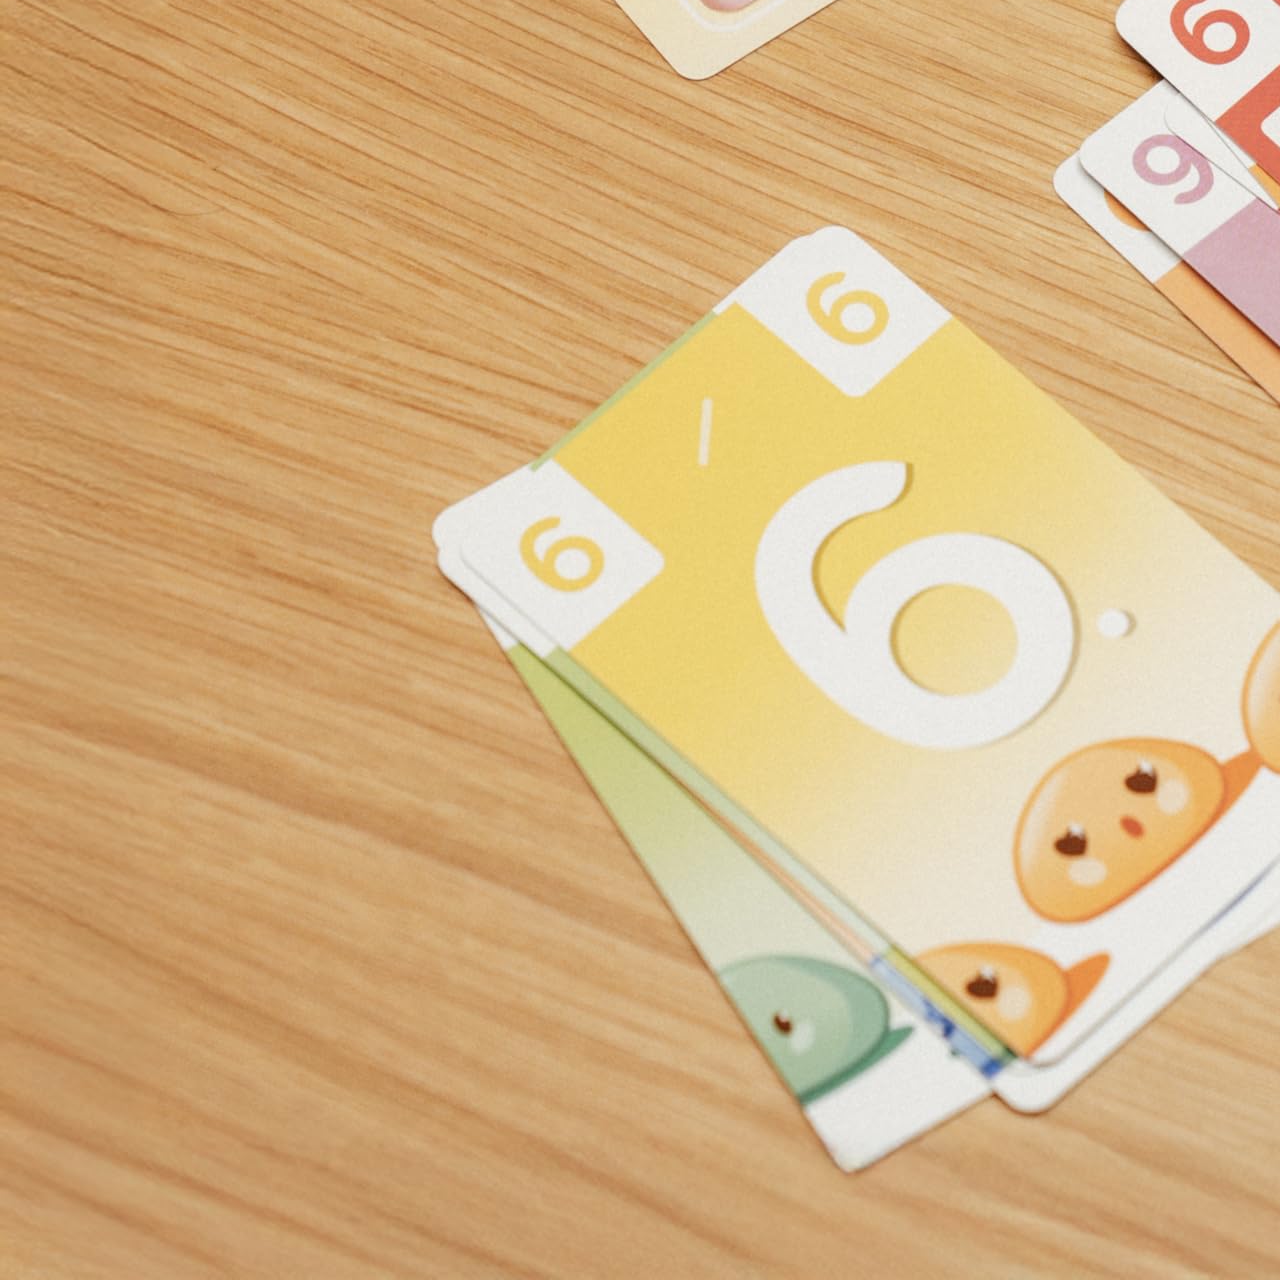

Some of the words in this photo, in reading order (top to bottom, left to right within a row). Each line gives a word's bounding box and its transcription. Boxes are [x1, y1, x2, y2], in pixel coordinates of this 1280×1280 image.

[1131, 133, 1214, 205] 9
[806, 271, 890, 345] 6
[519, 516, 605, 593] 6
